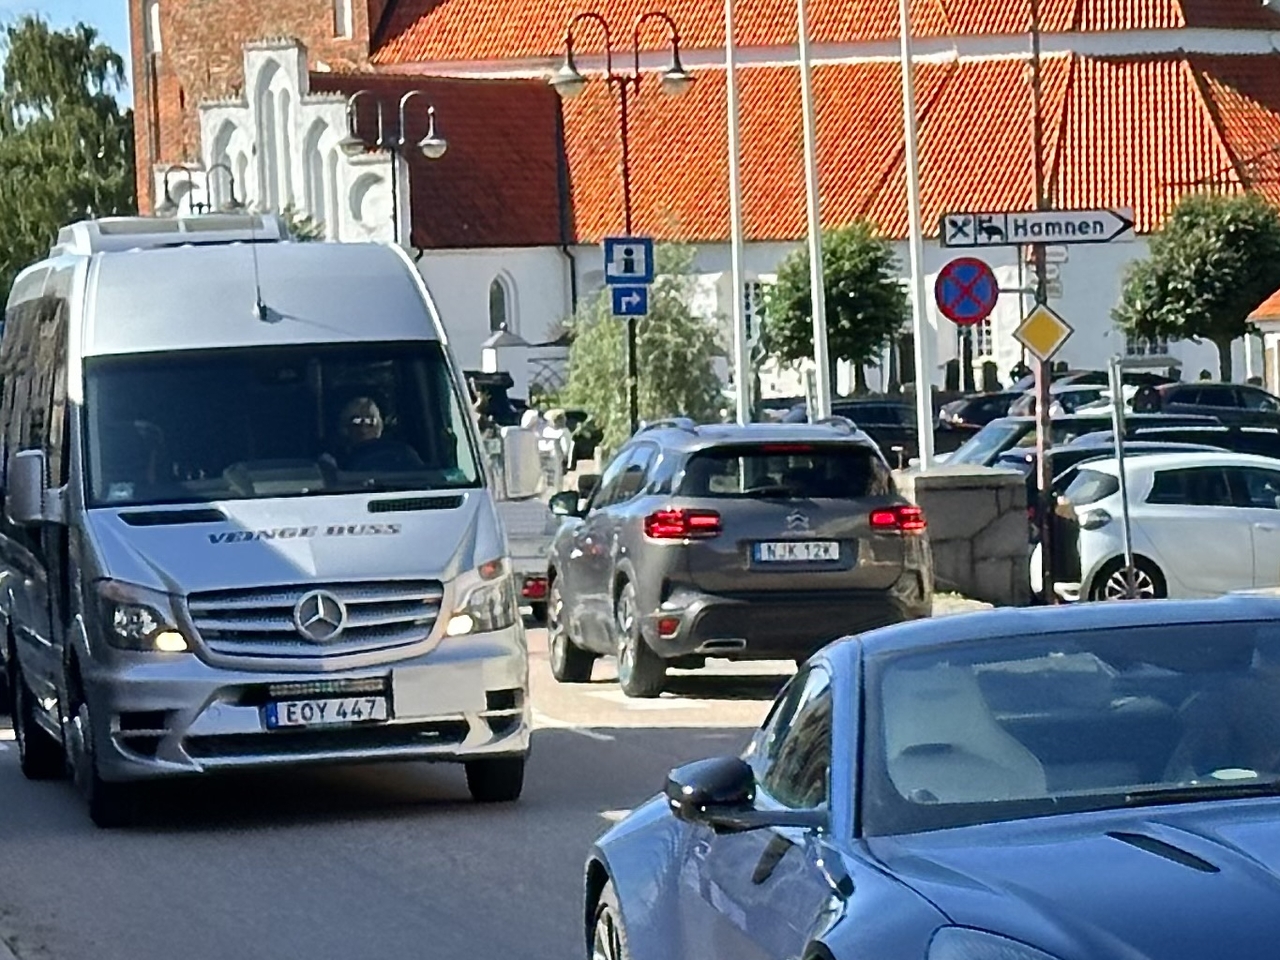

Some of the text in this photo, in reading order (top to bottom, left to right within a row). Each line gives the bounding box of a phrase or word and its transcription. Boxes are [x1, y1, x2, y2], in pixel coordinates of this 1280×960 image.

[1013, 218, 1105, 238] Hamnen
[323, 523, 402, 537] BUSS
[766, 543, 797, 559] NJK
[286, 699, 377, 723] EOY 447
